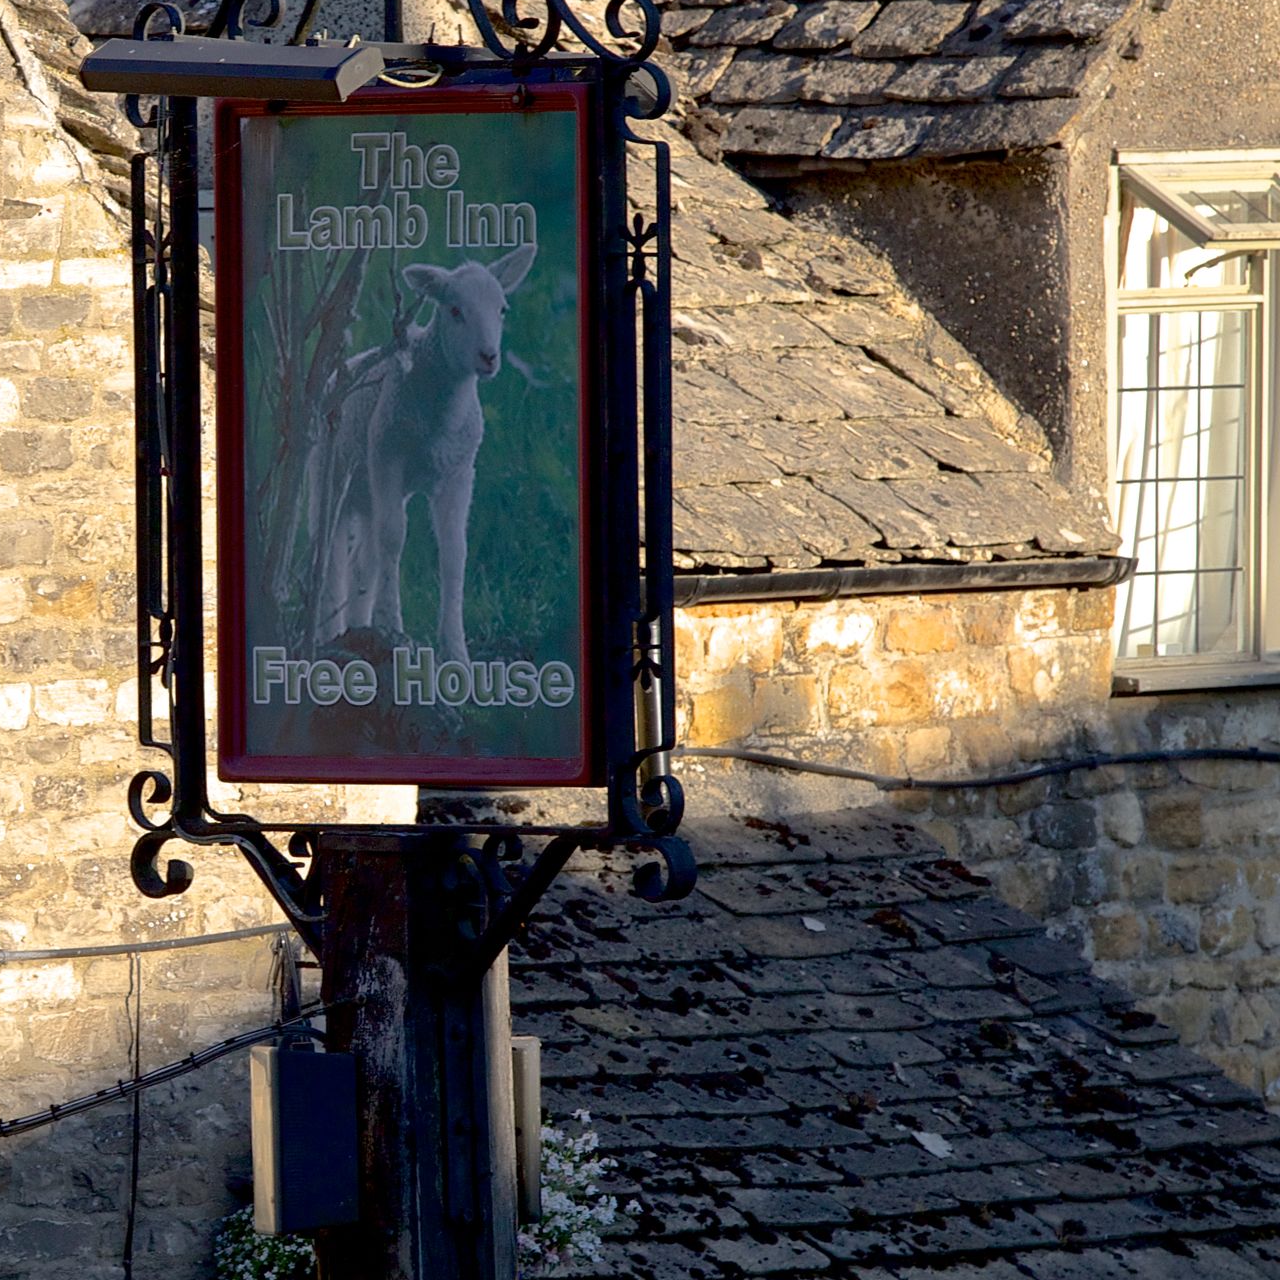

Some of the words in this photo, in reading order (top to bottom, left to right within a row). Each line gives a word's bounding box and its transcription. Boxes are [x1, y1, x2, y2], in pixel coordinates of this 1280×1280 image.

[352, 133, 459, 188] The
[278, 194, 427, 249] Lamb
[448, 191, 536, 246] Inn
[254, 647, 376, 704] Free
[394, 648, 574, 705] House
